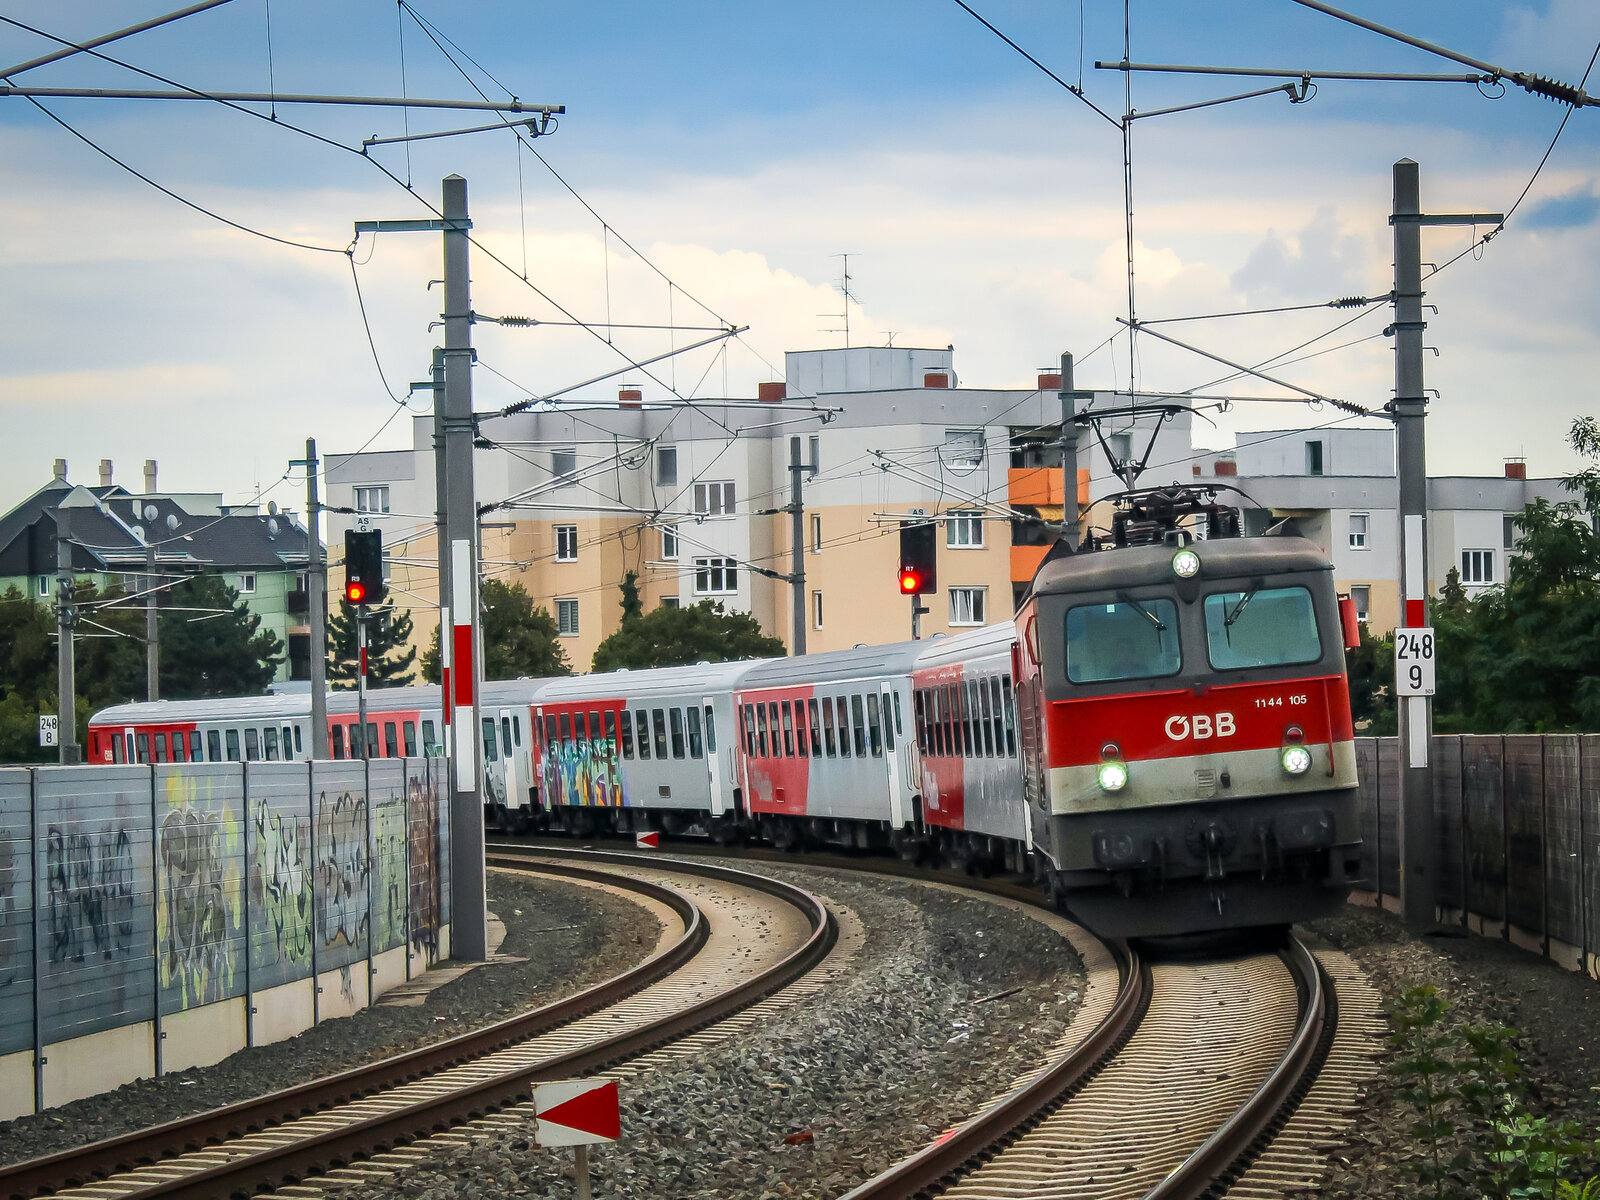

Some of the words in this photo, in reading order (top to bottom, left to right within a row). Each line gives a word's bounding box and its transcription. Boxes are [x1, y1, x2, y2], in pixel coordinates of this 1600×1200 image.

[1398, 634, 1432, 659] 248
[1409, 665, 1422, 689] 9
[1254, 697, 1282, 708] 1144
[1288, 694, 1307, 705] 105
[42, 718, 56, 730] 248
[1164, 712, 1236, 741] ÖBB
[46, 732, 52, 743] 8
